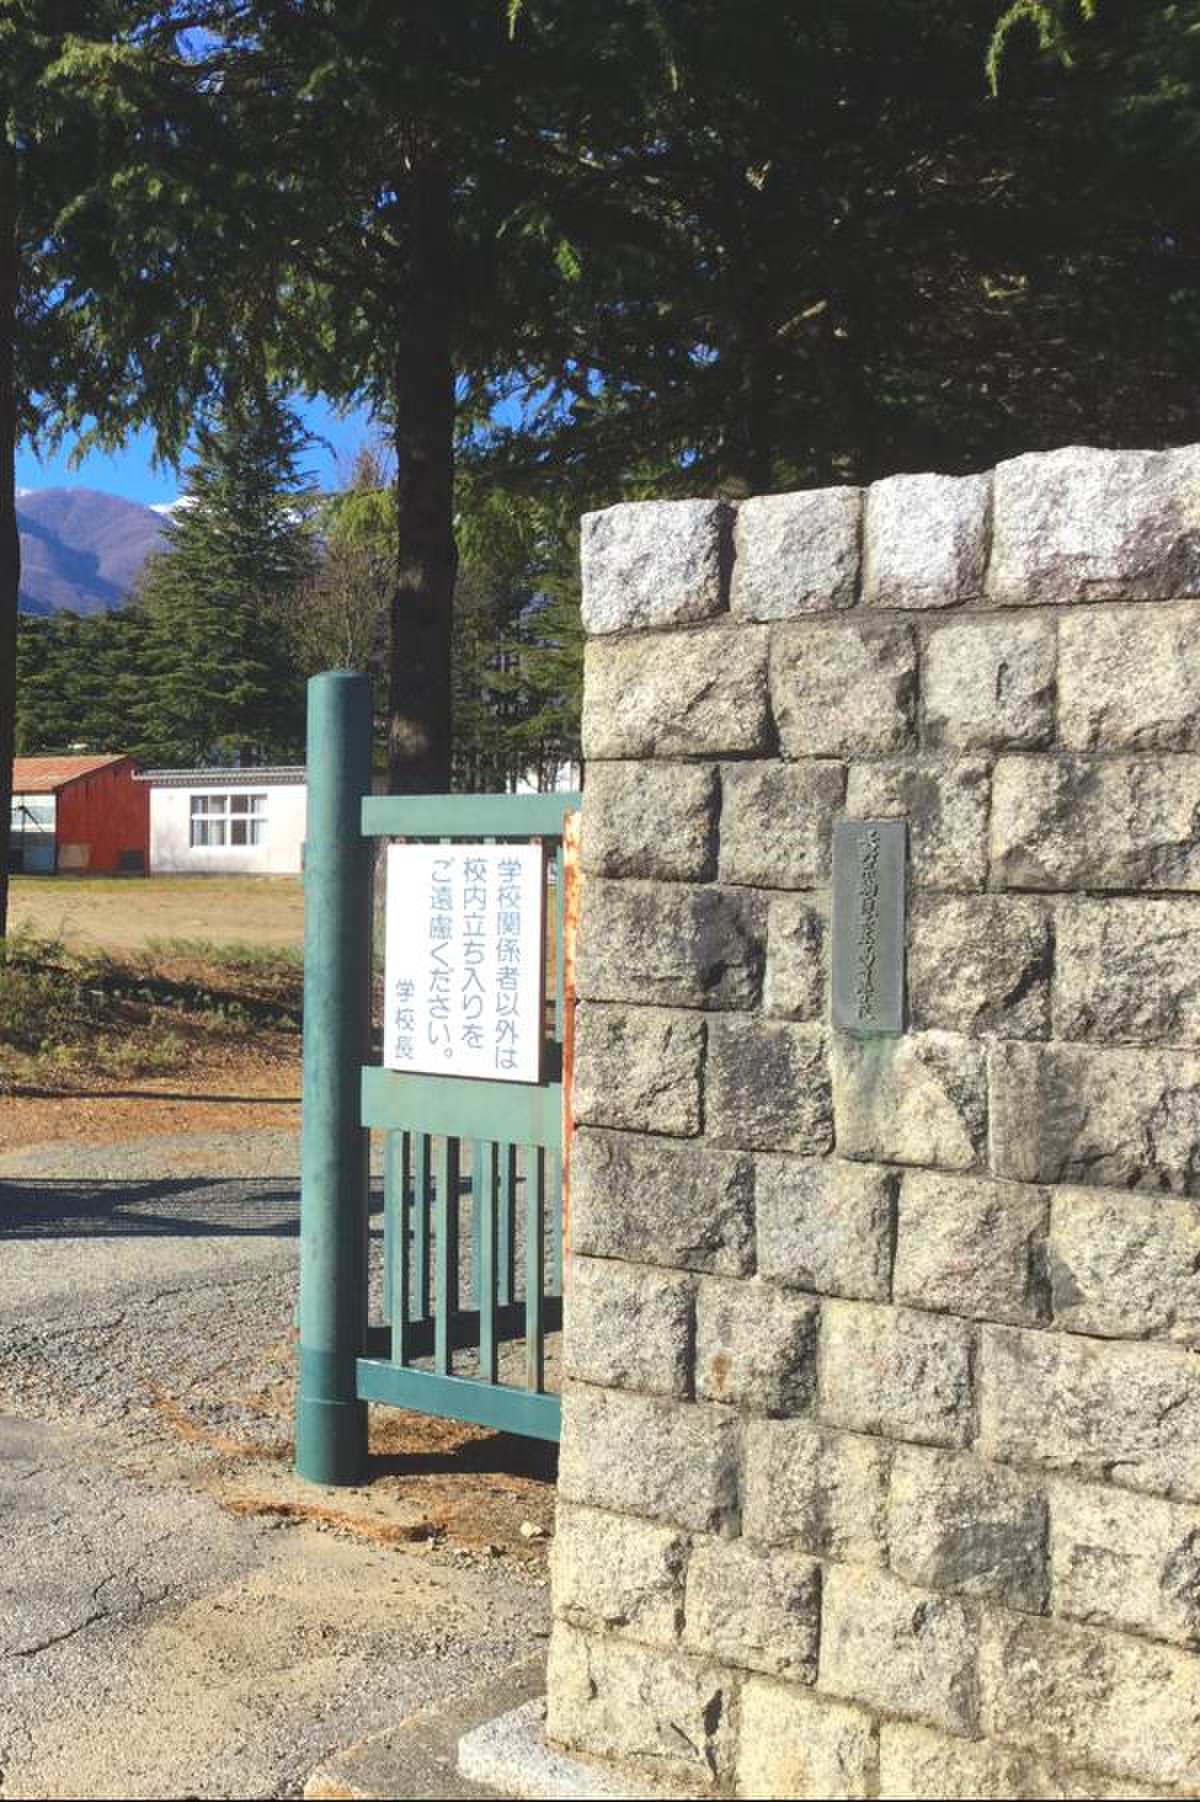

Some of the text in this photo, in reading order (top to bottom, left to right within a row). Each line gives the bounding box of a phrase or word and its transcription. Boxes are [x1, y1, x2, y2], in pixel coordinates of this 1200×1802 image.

[395, 978, 415, 1060] 学校長
[427, 857, 455, 1059] ご遠慮ください。
[461, 856, 488, 1049] 校内立ち入りを
[495, 857, 522, 1069] 学校関係者以外は
